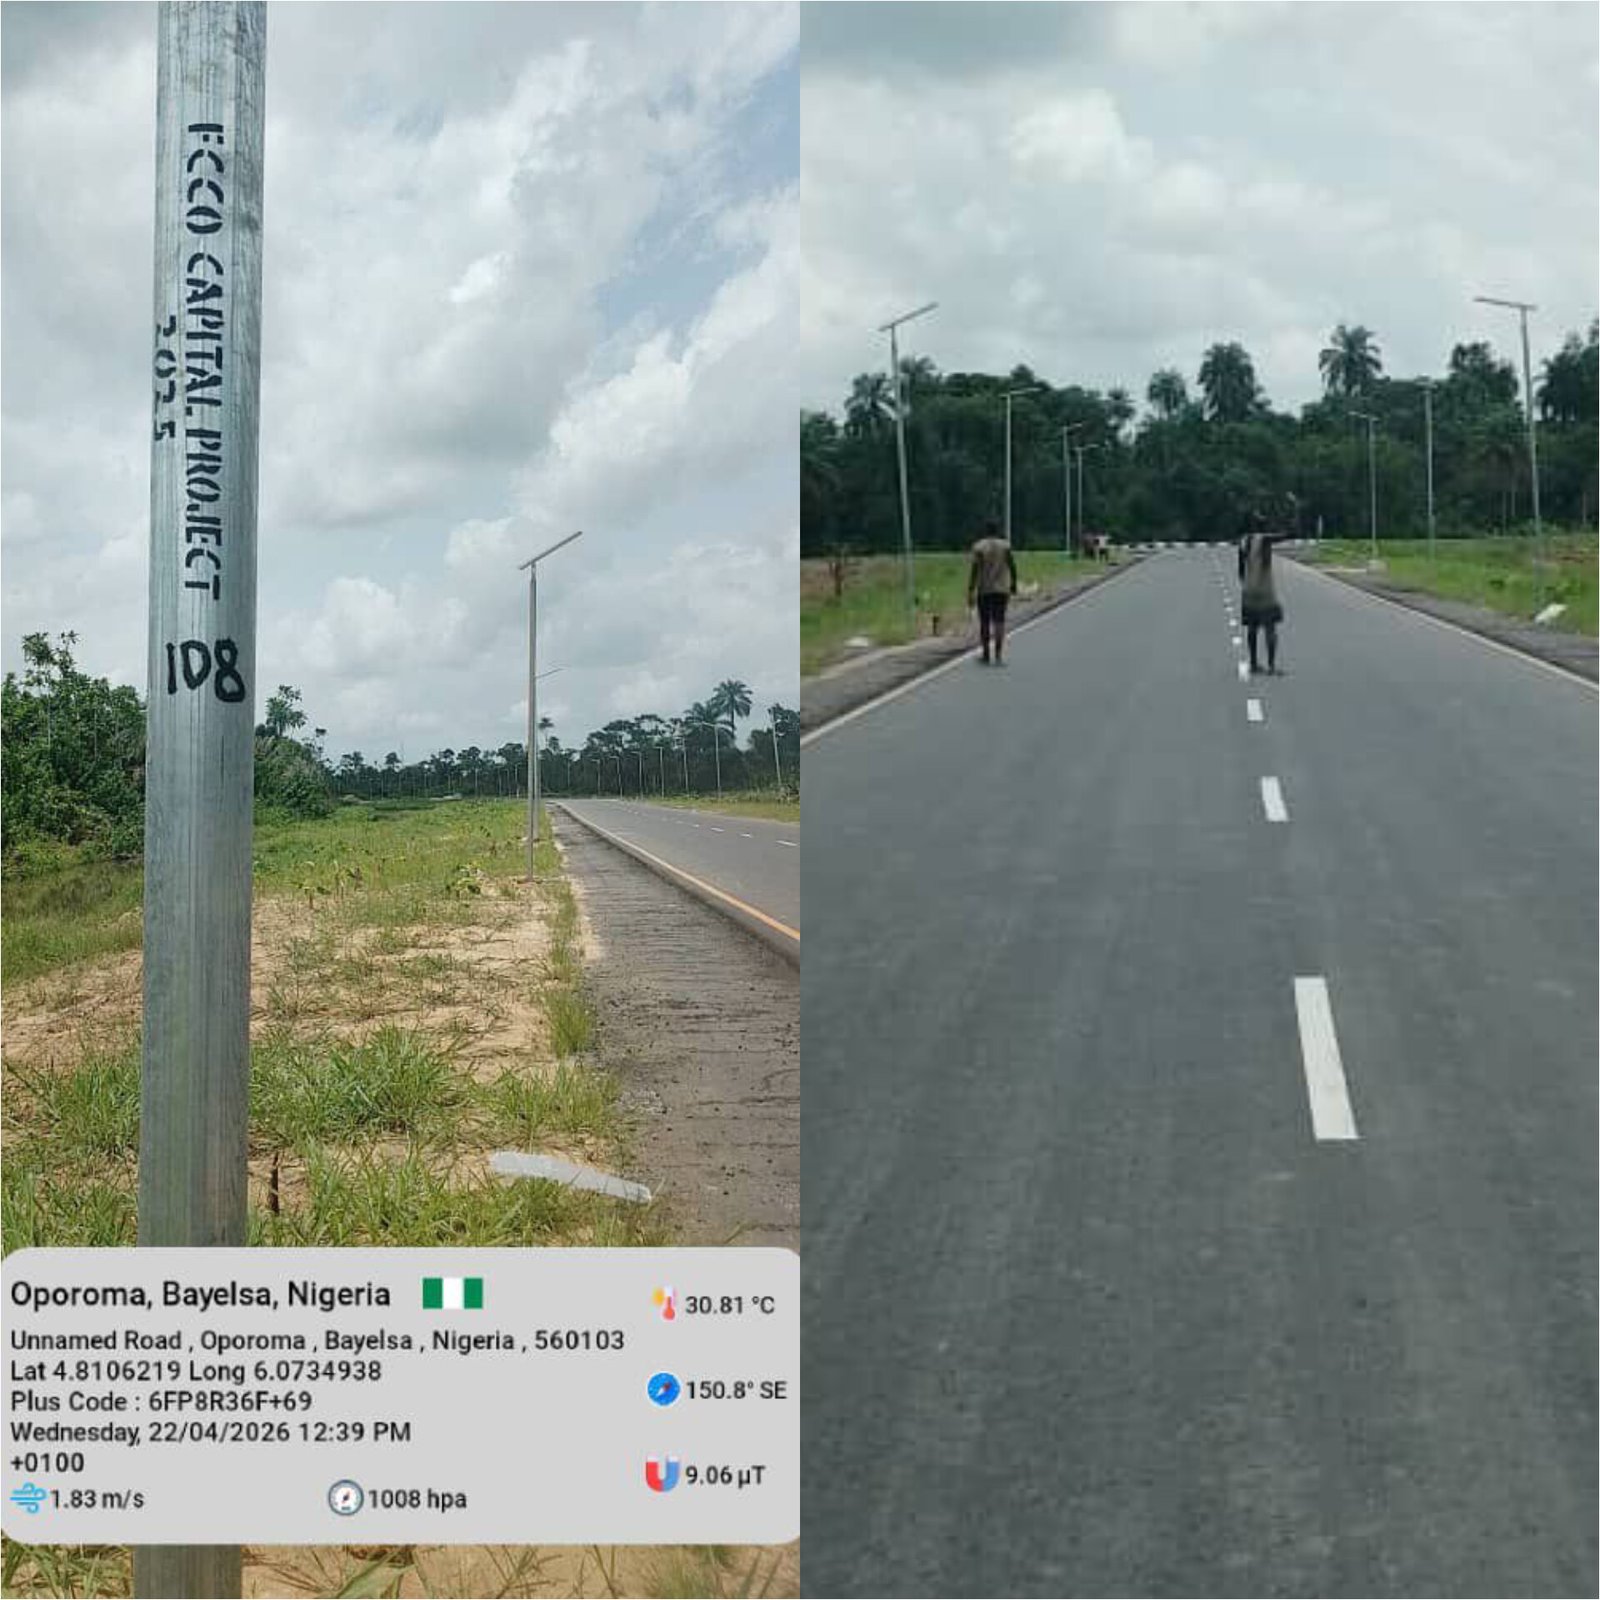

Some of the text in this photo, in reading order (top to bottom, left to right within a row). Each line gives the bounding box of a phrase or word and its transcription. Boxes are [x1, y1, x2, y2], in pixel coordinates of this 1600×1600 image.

[153, 315, 177, 441] 2025
[185, 252, 224, 416] CAPITAL
[184, 428, 223, 600] PROJECT
[166, 638, 246, 703] 108
